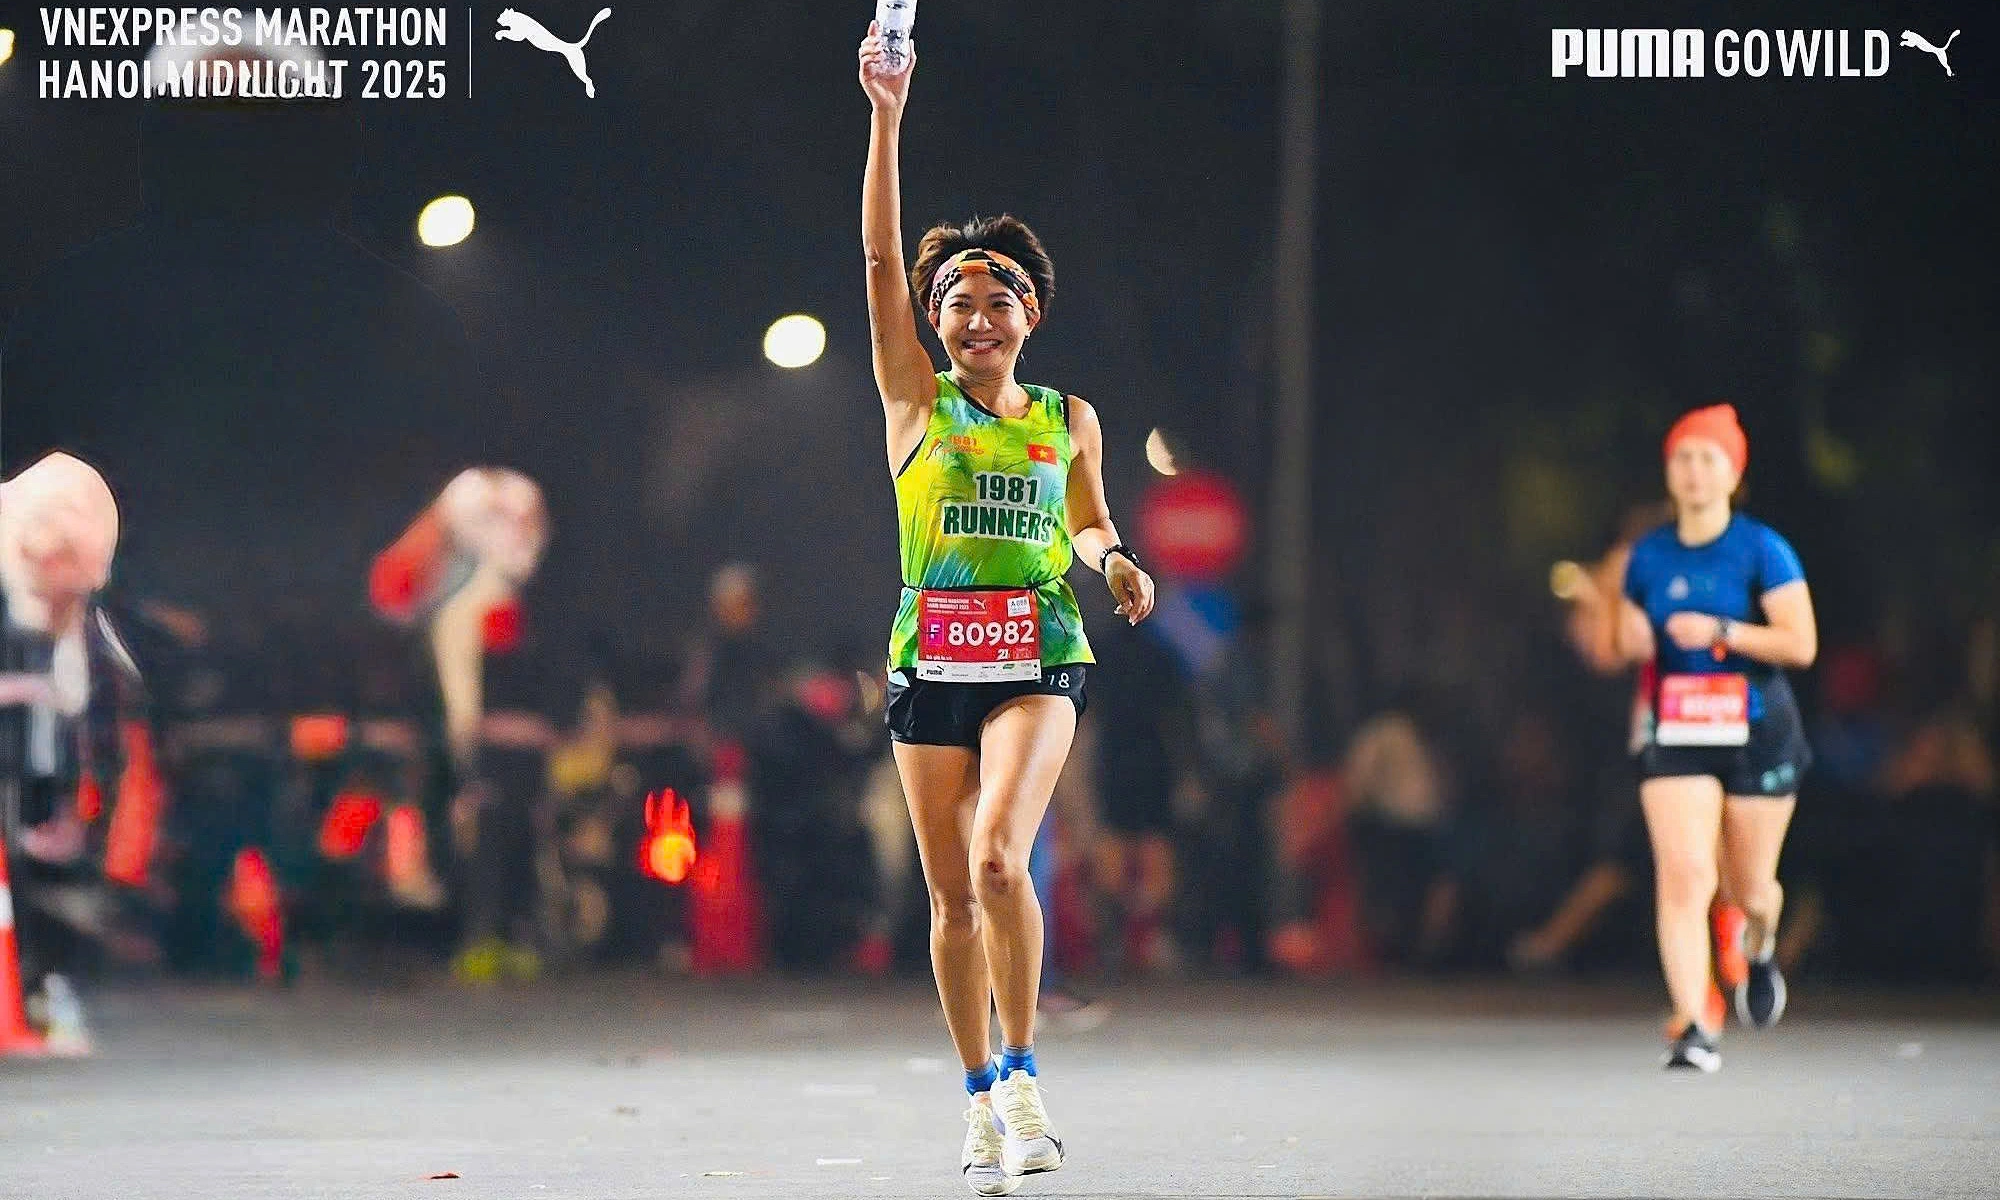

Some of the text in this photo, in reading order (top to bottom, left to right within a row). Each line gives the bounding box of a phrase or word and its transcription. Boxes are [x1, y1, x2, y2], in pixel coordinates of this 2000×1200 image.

[976, 474, 1039, 505] 1981
[944, 506, 1055, 543] RUNNERS
[948, 620, 1035, 647] 80982
